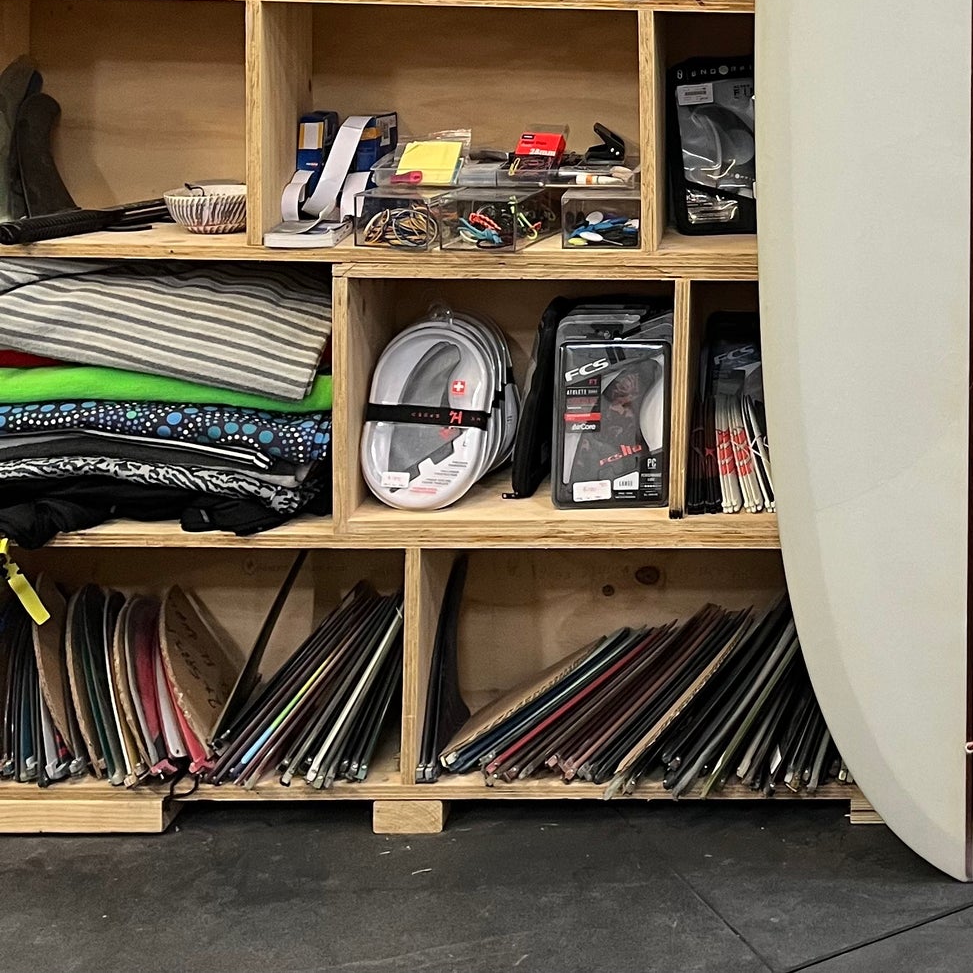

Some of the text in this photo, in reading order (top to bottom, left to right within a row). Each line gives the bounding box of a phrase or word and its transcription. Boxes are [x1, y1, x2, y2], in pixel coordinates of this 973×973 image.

[714, 345, 755, 365] FCS
[564, 358, 610, 382] FCS
[647, 458, 657, 468] PC
